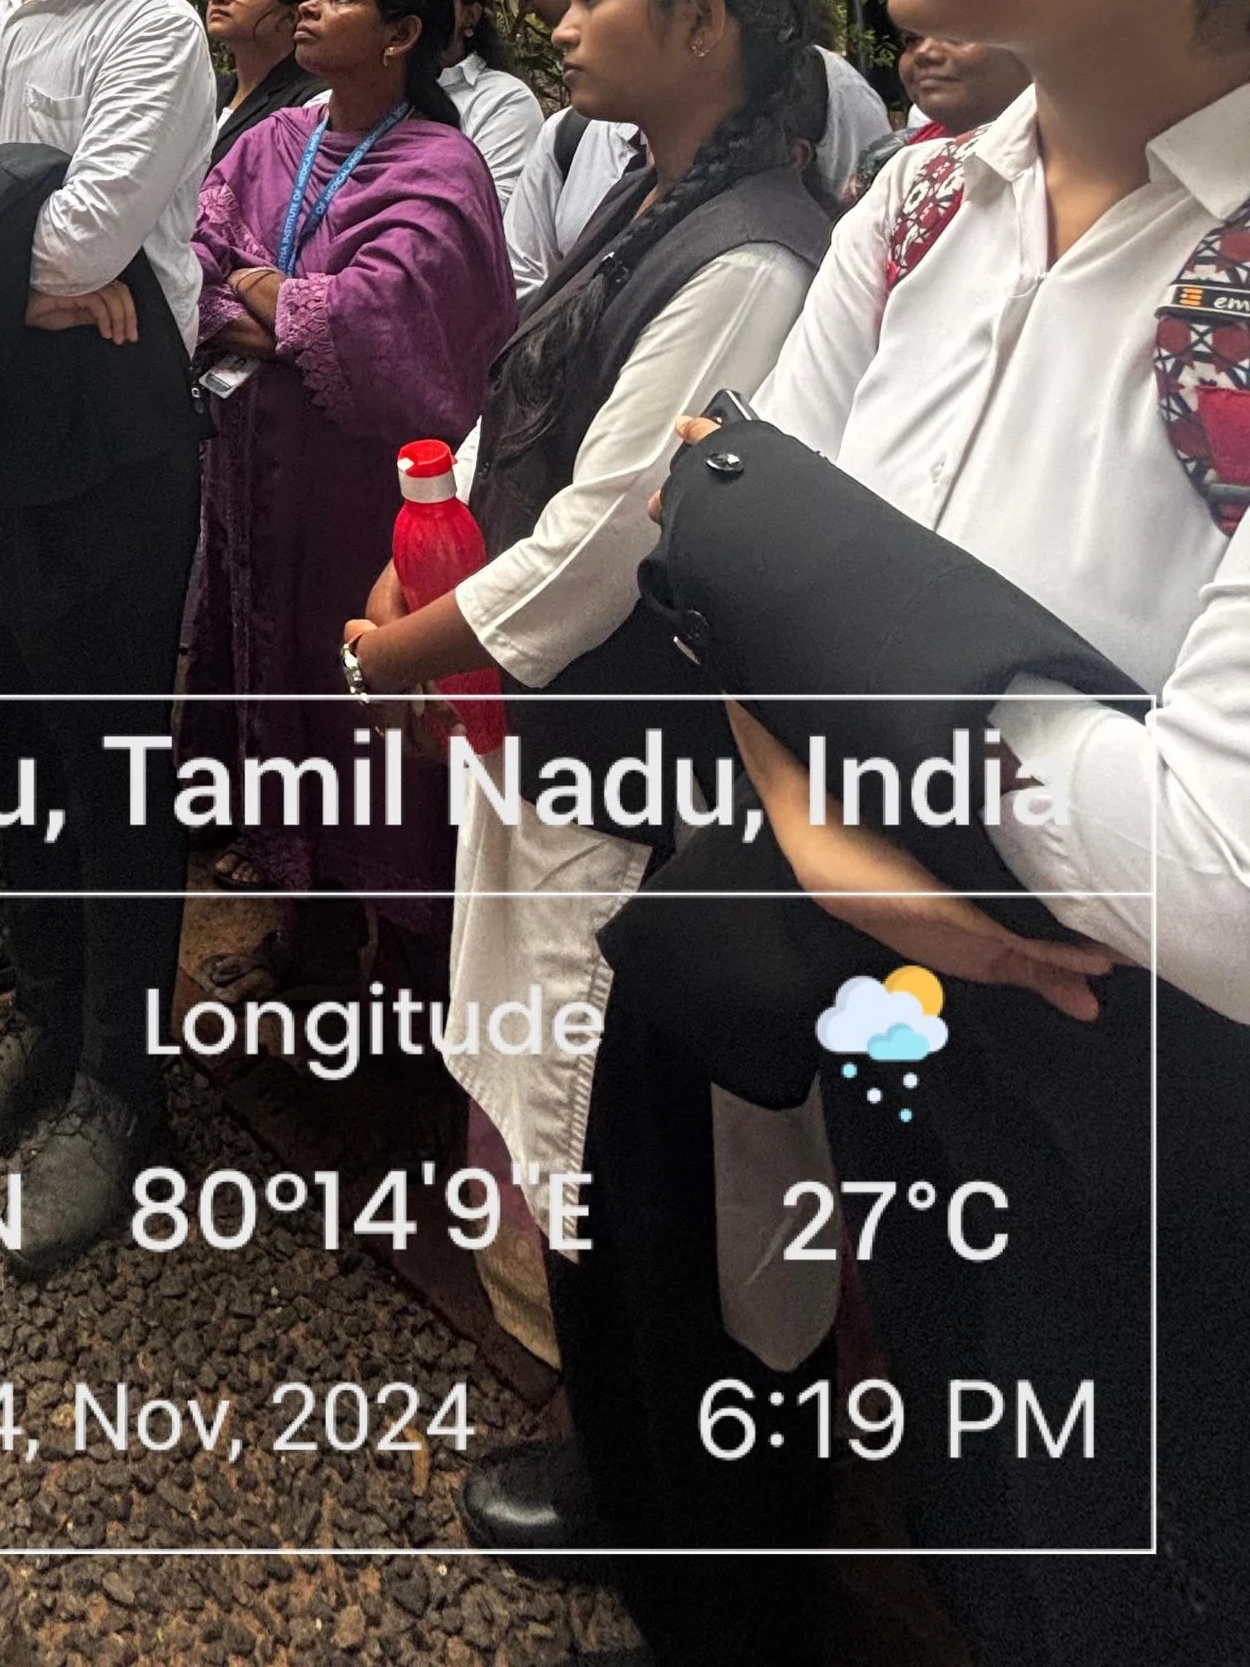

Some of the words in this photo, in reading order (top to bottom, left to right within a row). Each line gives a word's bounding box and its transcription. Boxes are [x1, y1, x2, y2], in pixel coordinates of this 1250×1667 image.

[316, 200, 327, 214] OF
[323, 168, 351, 201] MEDICAL
[282, 203, 299, 244] INSTITUTE
